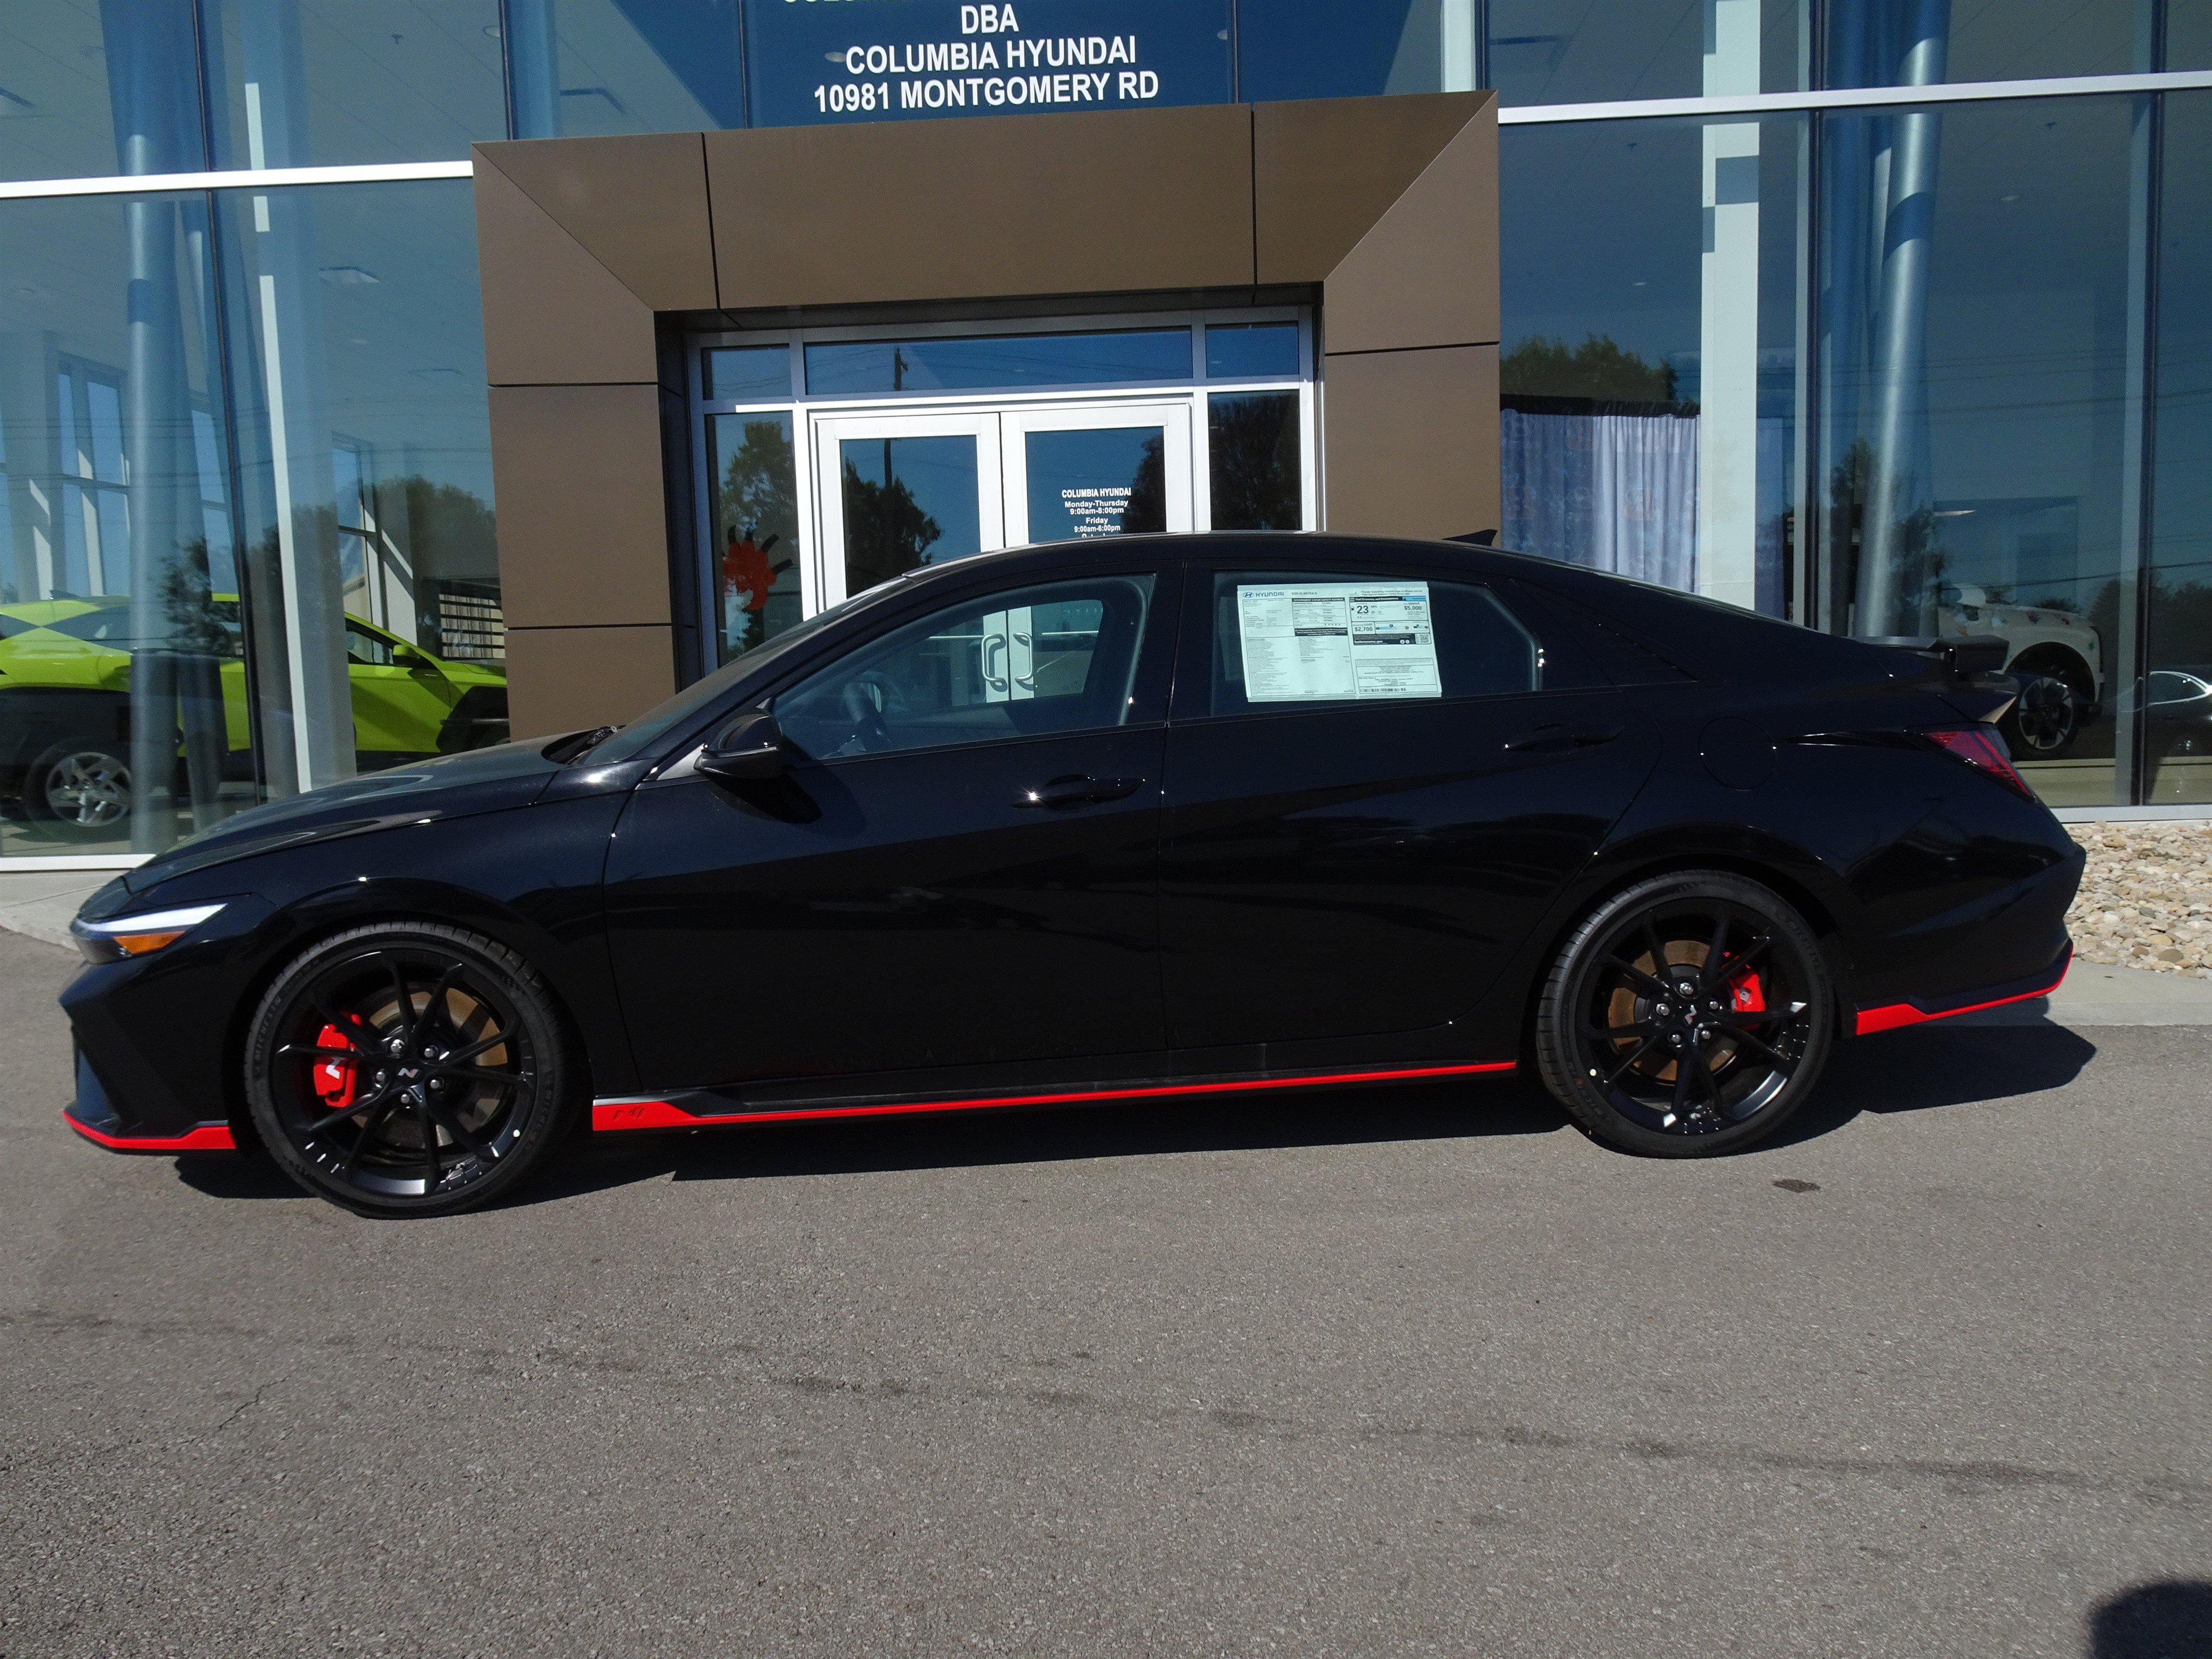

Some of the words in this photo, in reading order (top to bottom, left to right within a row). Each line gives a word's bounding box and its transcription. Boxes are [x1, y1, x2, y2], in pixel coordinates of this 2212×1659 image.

[961, 4, 1019, 34] DBA
[846, 42, 1000, 74] COLUMBIA
[1007, 35, 1136, 68] HYUNDAI
[814, 82, 888, 112] 10981
[901, 72, 1110, 109] MONTGOMERY
[1119, 71, 1159, 99] RD
[1062, 488, 1099, 498] COLUMBIA
[1100, 487, 1131, 497] HYUNDAI
[1064, 500, 1129, 508] Monday-Thursday
[1070, 507, 1124, 515] 9:00am-8:00pm
[1085, 517, 1108, 525] Friday
[1074, 524, 1121, 533] 9:00am-6:00pm
[1357, 605, 1369, 613] 23
